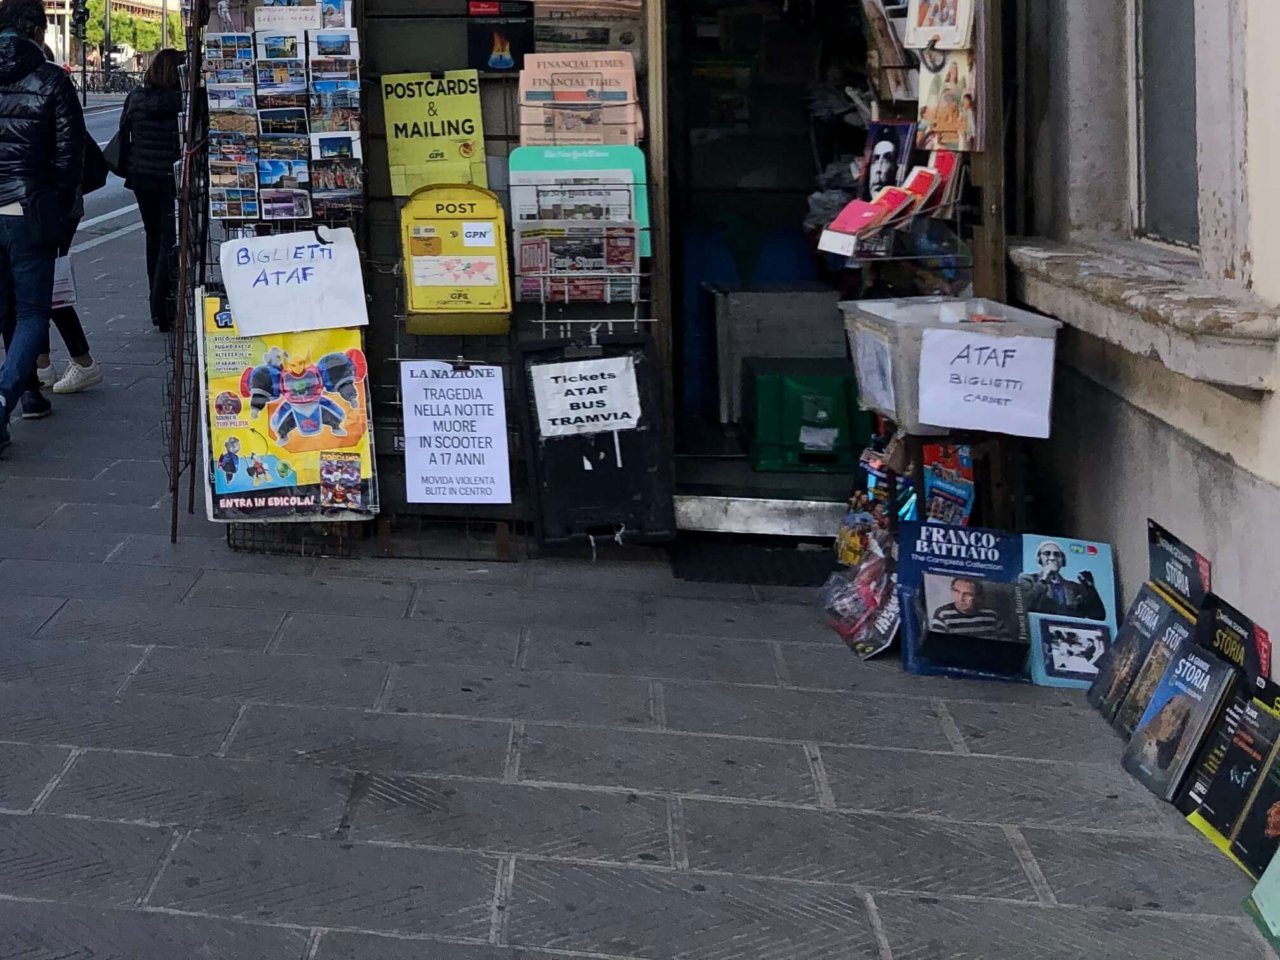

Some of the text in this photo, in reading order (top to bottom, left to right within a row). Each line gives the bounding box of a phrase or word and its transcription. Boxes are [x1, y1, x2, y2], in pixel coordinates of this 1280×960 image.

[536, 58, 625, 70] FINANCIAL TIMES
[532, 76, 622, 88] FINANCIAL TIMES
[384, 78, 478, 100] POSTCARDS
[427, 101, 439, 117] &
[393, 119, 475, 139] MAILING
[435, 203, 477, 215] POST
[465, 230, 487, 239] GPN
[252, 266, 315, 288] ATAF
[950, 343, 1018, 369] ATAF
[409, 368, 496, 379] LA NAZIONE
[550, 371, 617, 385] Tickets
[948, 373, 1024, 391] BIGLIETTI
[423, 388, 484, 401] TRAGEDIA
[563, 385, 609, 397] ATAF
[414, 403, 495, 417] NELLA NOTTE
[569, 399, 607, 410] BUS
[547, 411, 632, 427] TRAMVIA
[433, 420, 477, 433] MUORE
[420, 436, 493, 449] IN SCOOTER
[429, 453, 485, 466] A 17 ANNI
[421, 476, 496, 485] MOVIDA VIOLENTA
[425, 486, 492, 496] BLITZ IN CENTRO
[220, 495, 315, 508] ENTRA IN EDICOLA!
[921, 525, 997, 549] FRANCO
[916, 539, 1000, 562] BATTIATO
[911, 553, 925, 562] The
[1135, 600, 1160, 632] STORIA
[1213, 629, 1245, 666] STORIA
[1175, 658, 1211, 693] STORIA
